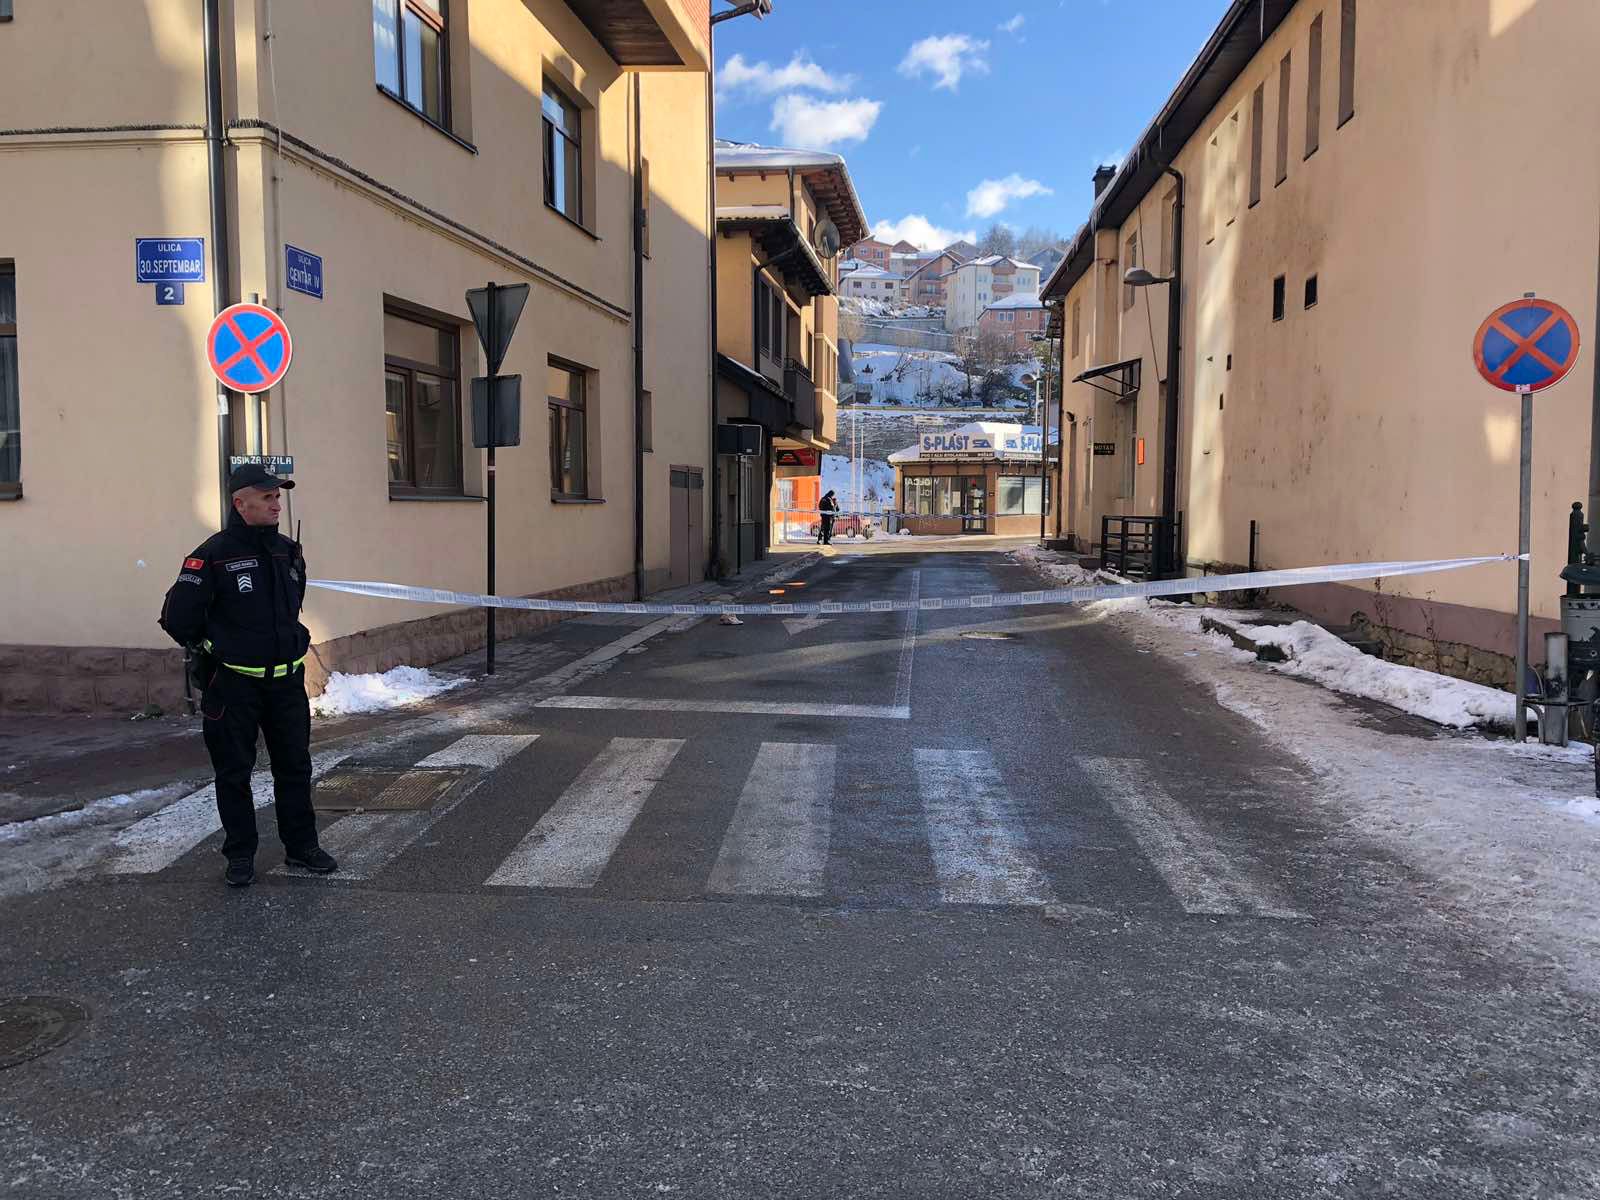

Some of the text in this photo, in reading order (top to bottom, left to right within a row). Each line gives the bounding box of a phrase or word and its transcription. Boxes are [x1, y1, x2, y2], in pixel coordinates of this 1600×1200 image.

[157, 243, 182, 252] ULICA
[140, 259, 201, 274] 30.SEPTEMBAR
[163, 286, 175, 300] 2
[923, 435, 970, 451] S-PLAST
